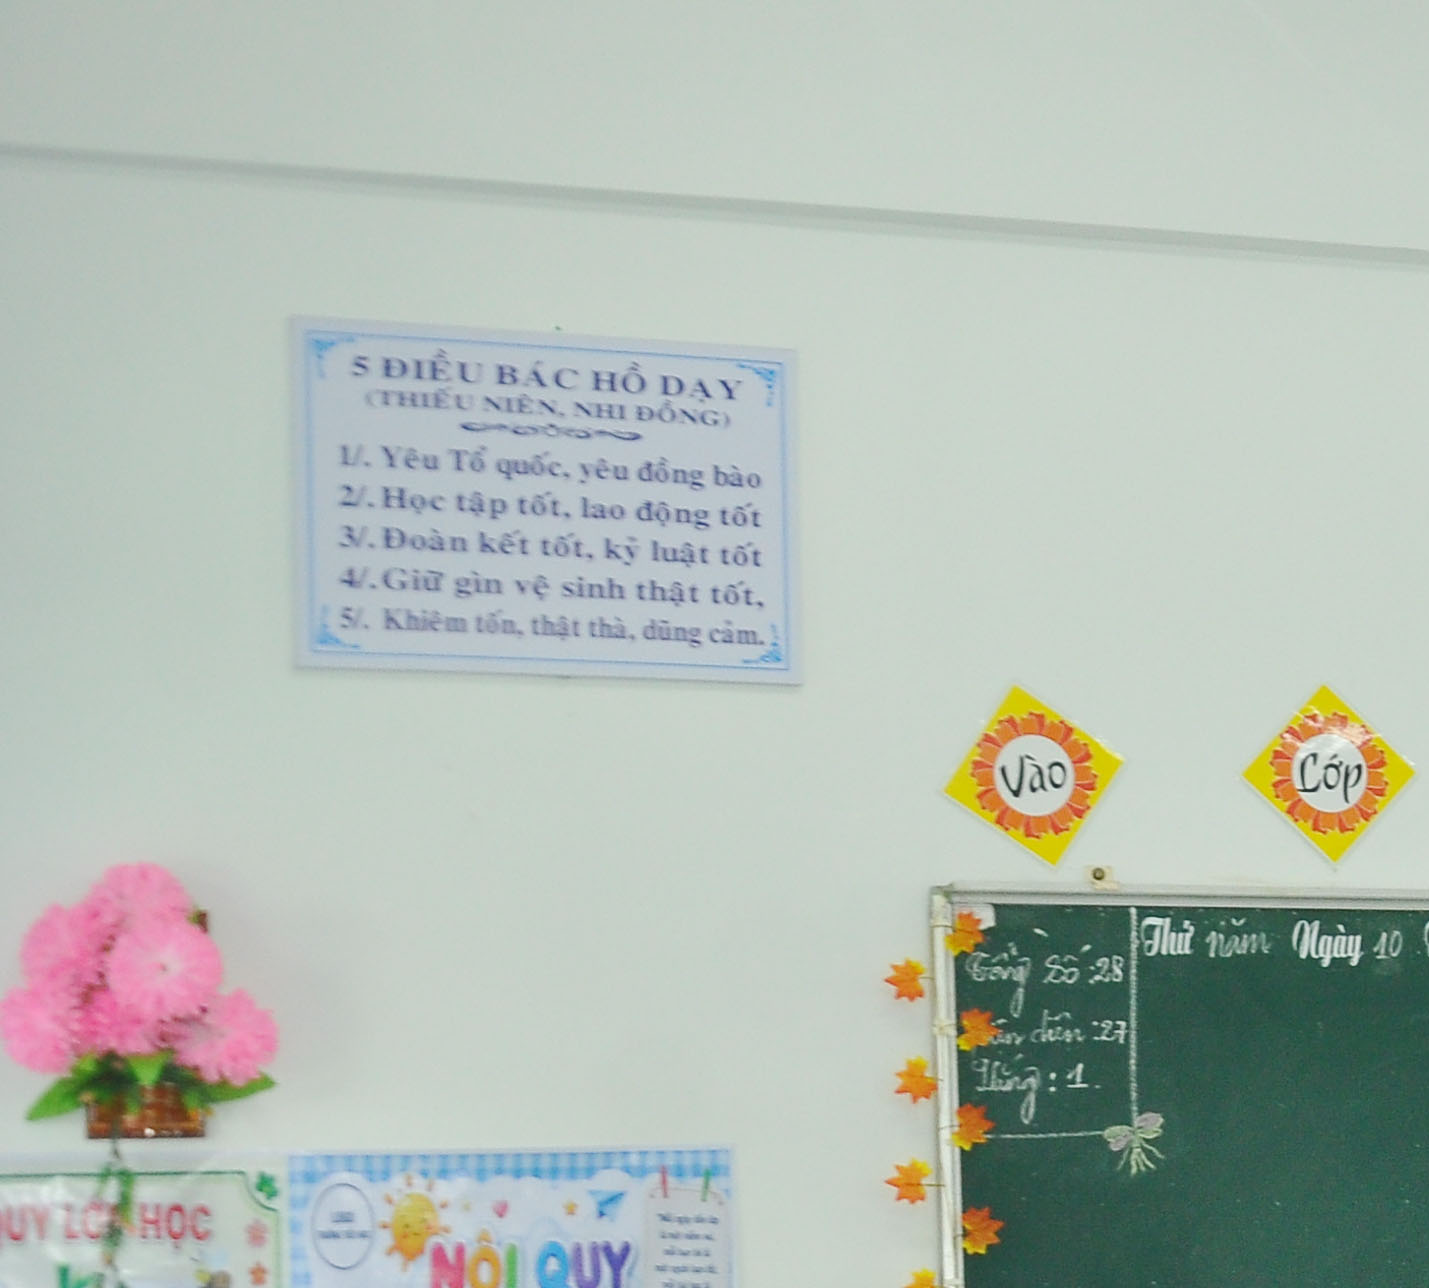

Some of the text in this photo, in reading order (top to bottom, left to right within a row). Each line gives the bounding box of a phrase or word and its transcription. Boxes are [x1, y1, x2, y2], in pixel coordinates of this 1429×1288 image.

[352, 348, 743, 402] 5 ĐIỀU BÁC HỒ DẠY
[365, 387, 476, 411] (THIẾU
[574, 401, 626, 420] NHI
[635, 400, 732, 428] ĐỒNG)
[381, 445, 440, 470] Yêu
[450, 445, 487, 472] Tổ
[495, 450, 570, 480] quốc,
[578, 457, 630, 484] yêu
[637, 457, 706, 491] đồng
[713, 465, 762, 489] bào
[382, 486, 447, 515] Học
[456, 491, 509, 519] tập
[517, 491, 571, 518] tốt,
[581, 496, 626, 520] lao
[636, 499, 710, 530] động
[720, 503, 763, 528] tốt
[382, 527, 469, 552] Đoàn
[478, 529, 529, 555] kết
[540, 532, 595, 560] tốt,
[651, 540, 711, 568] luật
[720, 542, 763, 568] tốt
[382, 567, 444, 592] Giữ
[454, 571, 503, 598] gìn
[514, 574, 551, 601] vệ
[561, 576, 627, 600] sinh
[636, 580, 701, 608] thật
[710, 580, 766, 608] tốt,
[383, 608, 469, 633] Khiêm
[475, 609, 525, 641] tốn,
[532, 614, 581, 641] thật
[588, 616, 637, 642] thà,
[642, 618, 704, 648] dũng
[708, 620, 767, 646] cảm.
[1000, 753, 1068, 799] Vào
[1296, 752, 1363, 804] Lớp
[1141, 916, 1195, 957] Thứ
[1206, 917, 1272, 958] năm
[1292, 919, 1364, 968] Ngày
[1373, 930, 1403, 959] 10
[0, 1206, 48, 1242] UY
[140, 1204, 212, 1250] HỌC
